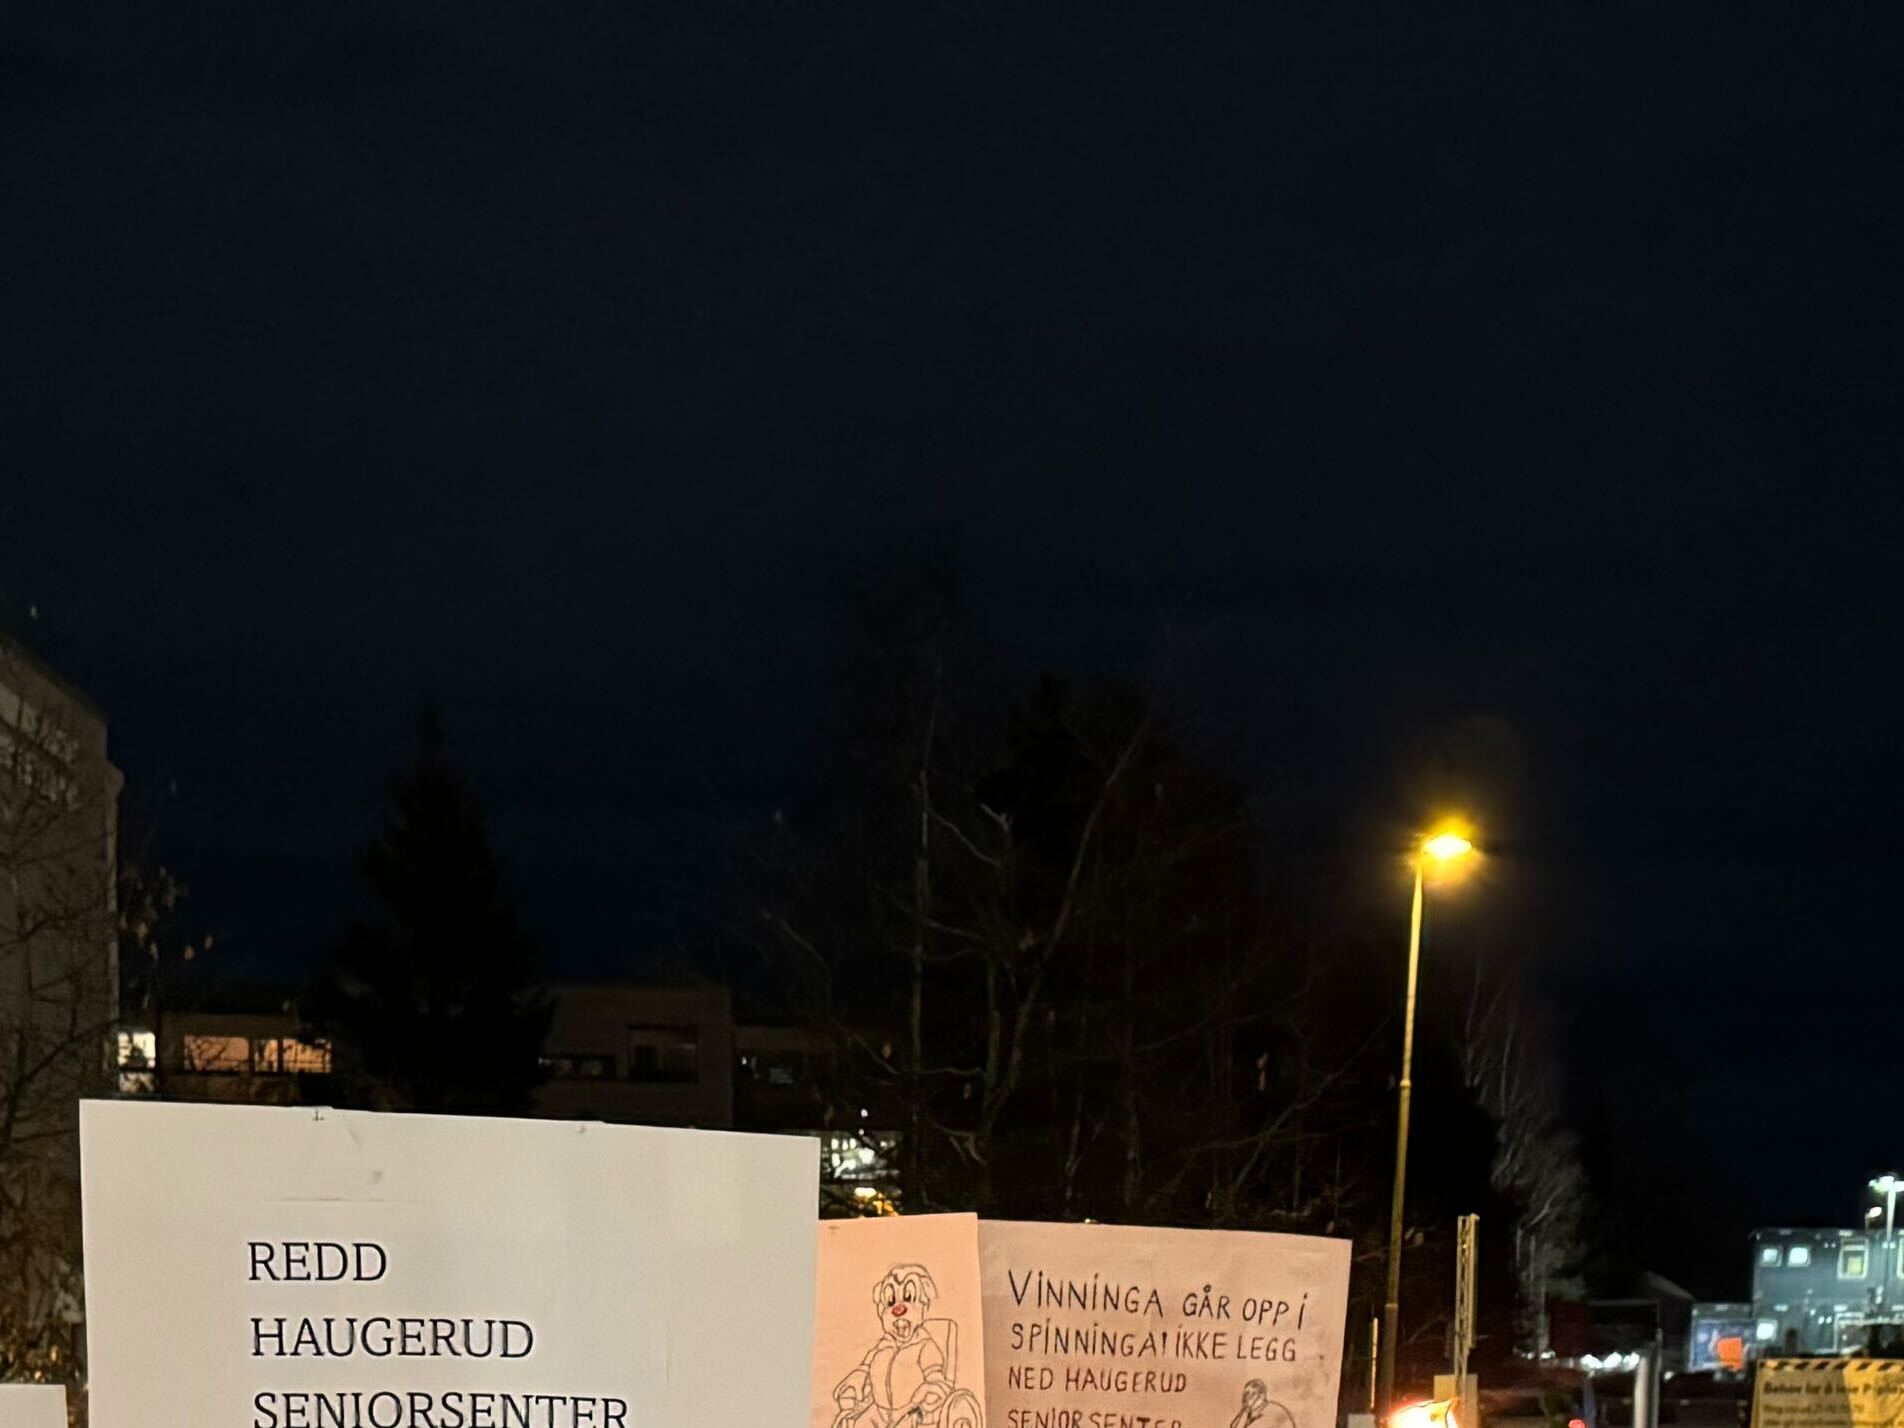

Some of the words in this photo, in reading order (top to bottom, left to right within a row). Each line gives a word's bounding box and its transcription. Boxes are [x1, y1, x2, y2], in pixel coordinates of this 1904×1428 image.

[247, 1241, 387, 1282] REDD
[1007, 1268, 1164, 1319] VINNINGA
[1182, 1283, 1231, 1321] GÅR
[1242, 1297, 1290, 1327] OPP
[250, 1317, 534, 1358] HAUGERUD
[1175, 1324, 1228, 1360] IKKE
[1236, 1332, 1297, 1362] LEGG
[1007, 1365, 1054, 1390] NED
[1064, 1366, 1187, 1393] HAUGERUD
